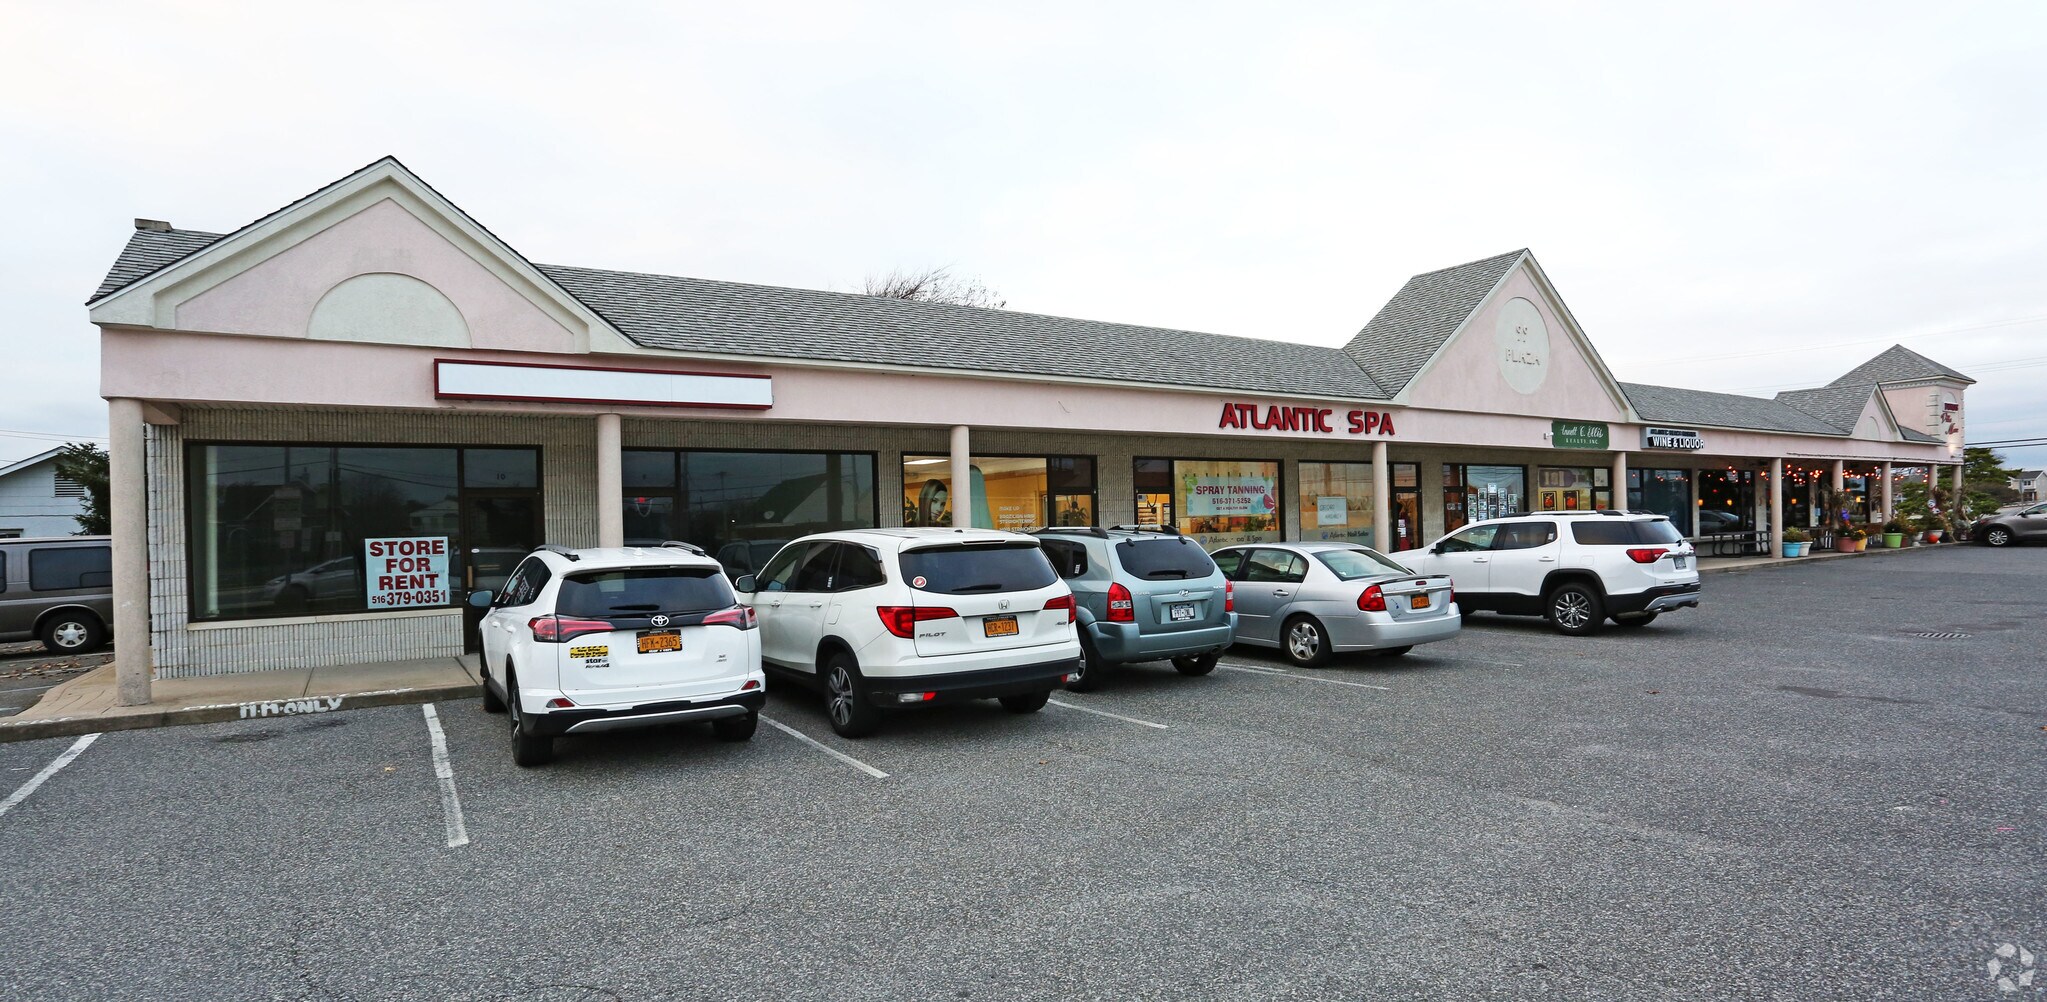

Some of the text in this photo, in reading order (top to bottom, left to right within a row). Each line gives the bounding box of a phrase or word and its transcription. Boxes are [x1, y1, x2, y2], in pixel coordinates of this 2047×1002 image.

[1505, 348, 1540, 366] PLAZA
[1219, 402, 1396, 436] ATLANTIC SPA
[1652, 436, 1705, 449] WINE & LIQUOR
[1196, 485, 1265, 495] SPRAY TANNING
[1212, 497, 1251, 505] 516-371-5252
[369, 540, 445, 557] STORE
[386, 558, 431, 573] FOR
[379, 574, 439, 590] RENT
[372, 590, 446, 606] 516 379-0351
